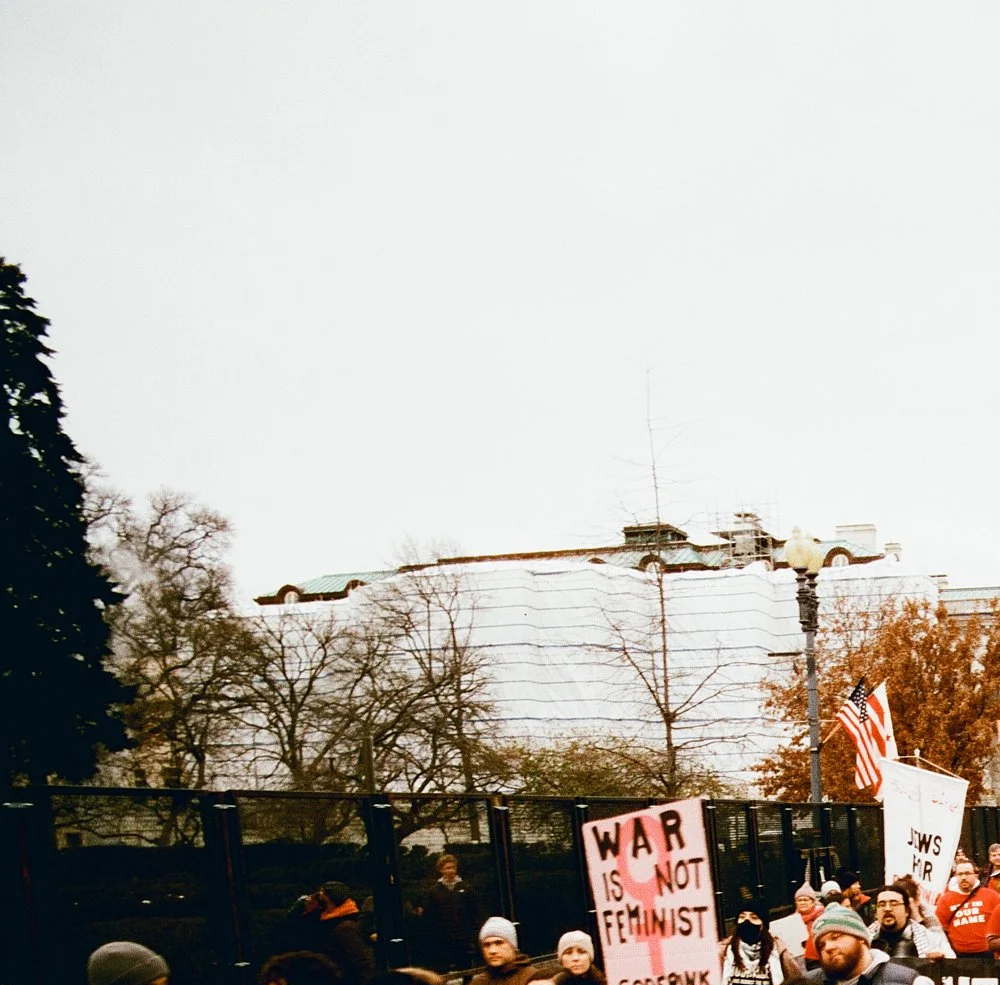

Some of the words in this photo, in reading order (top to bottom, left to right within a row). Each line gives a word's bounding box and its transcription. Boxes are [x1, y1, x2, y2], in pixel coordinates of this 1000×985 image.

[592, 810, 685, 861] WAR
[602, 870, 624, 902] IS
[655, 857, 704, 897] NOT
[603, 904, 708, 946] FEMINIST
[953, 914, 985, 927] NAME
[955, 907, 979, 918] OUR
